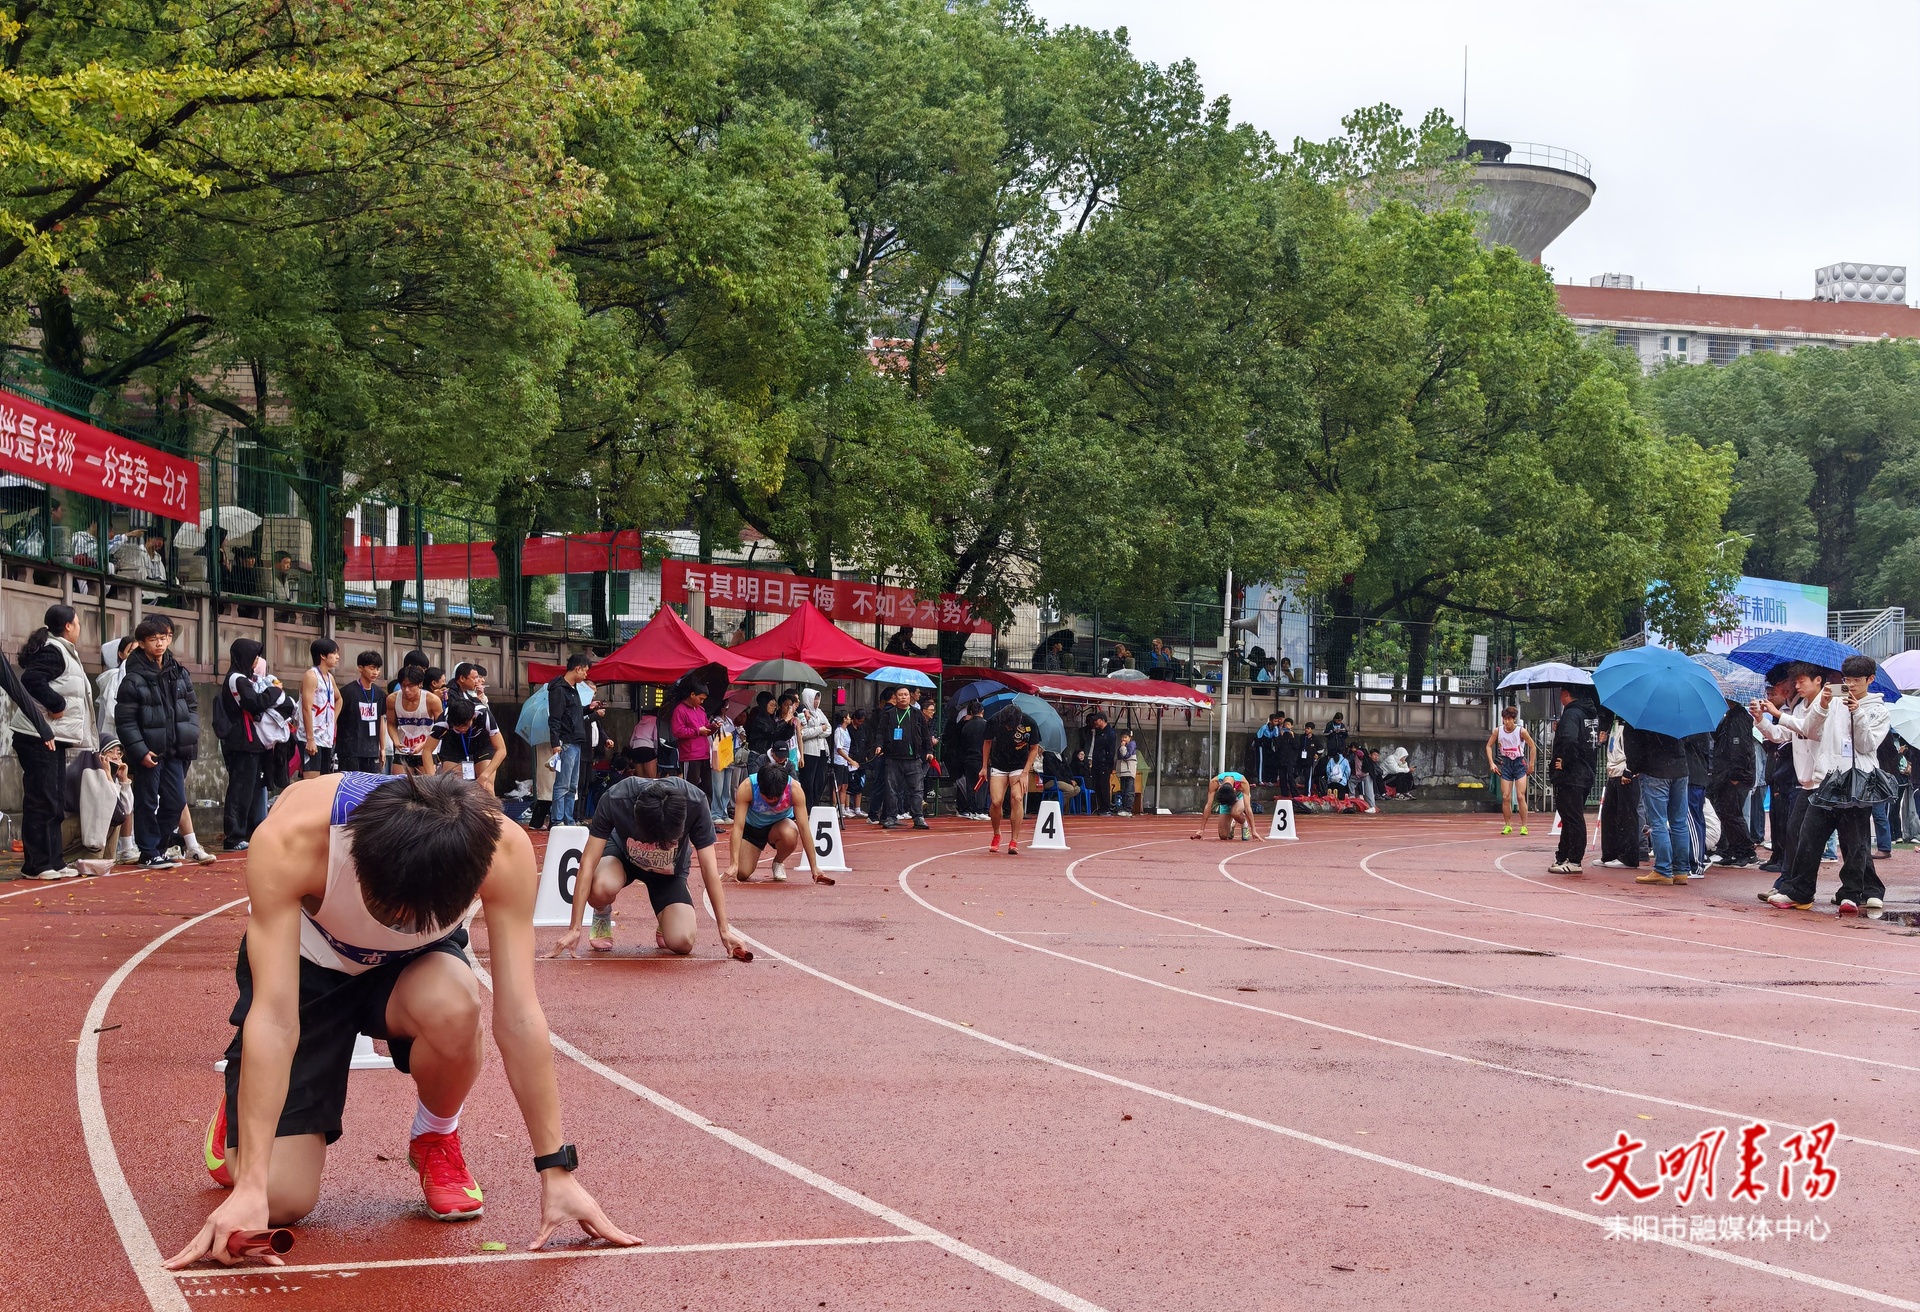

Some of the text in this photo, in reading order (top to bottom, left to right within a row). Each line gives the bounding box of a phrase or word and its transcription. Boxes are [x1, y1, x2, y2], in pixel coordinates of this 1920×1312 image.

[85, 445, 188, 510] 一分辛劳一分才
[682, 568, 836, 613] 与其明日后悔
[815, 821, 833, 857] 5
[1041, 811, 1056, 839] 4
[1277, 808, 1288, 832] 3
[558, 848, 583, 904] 6
